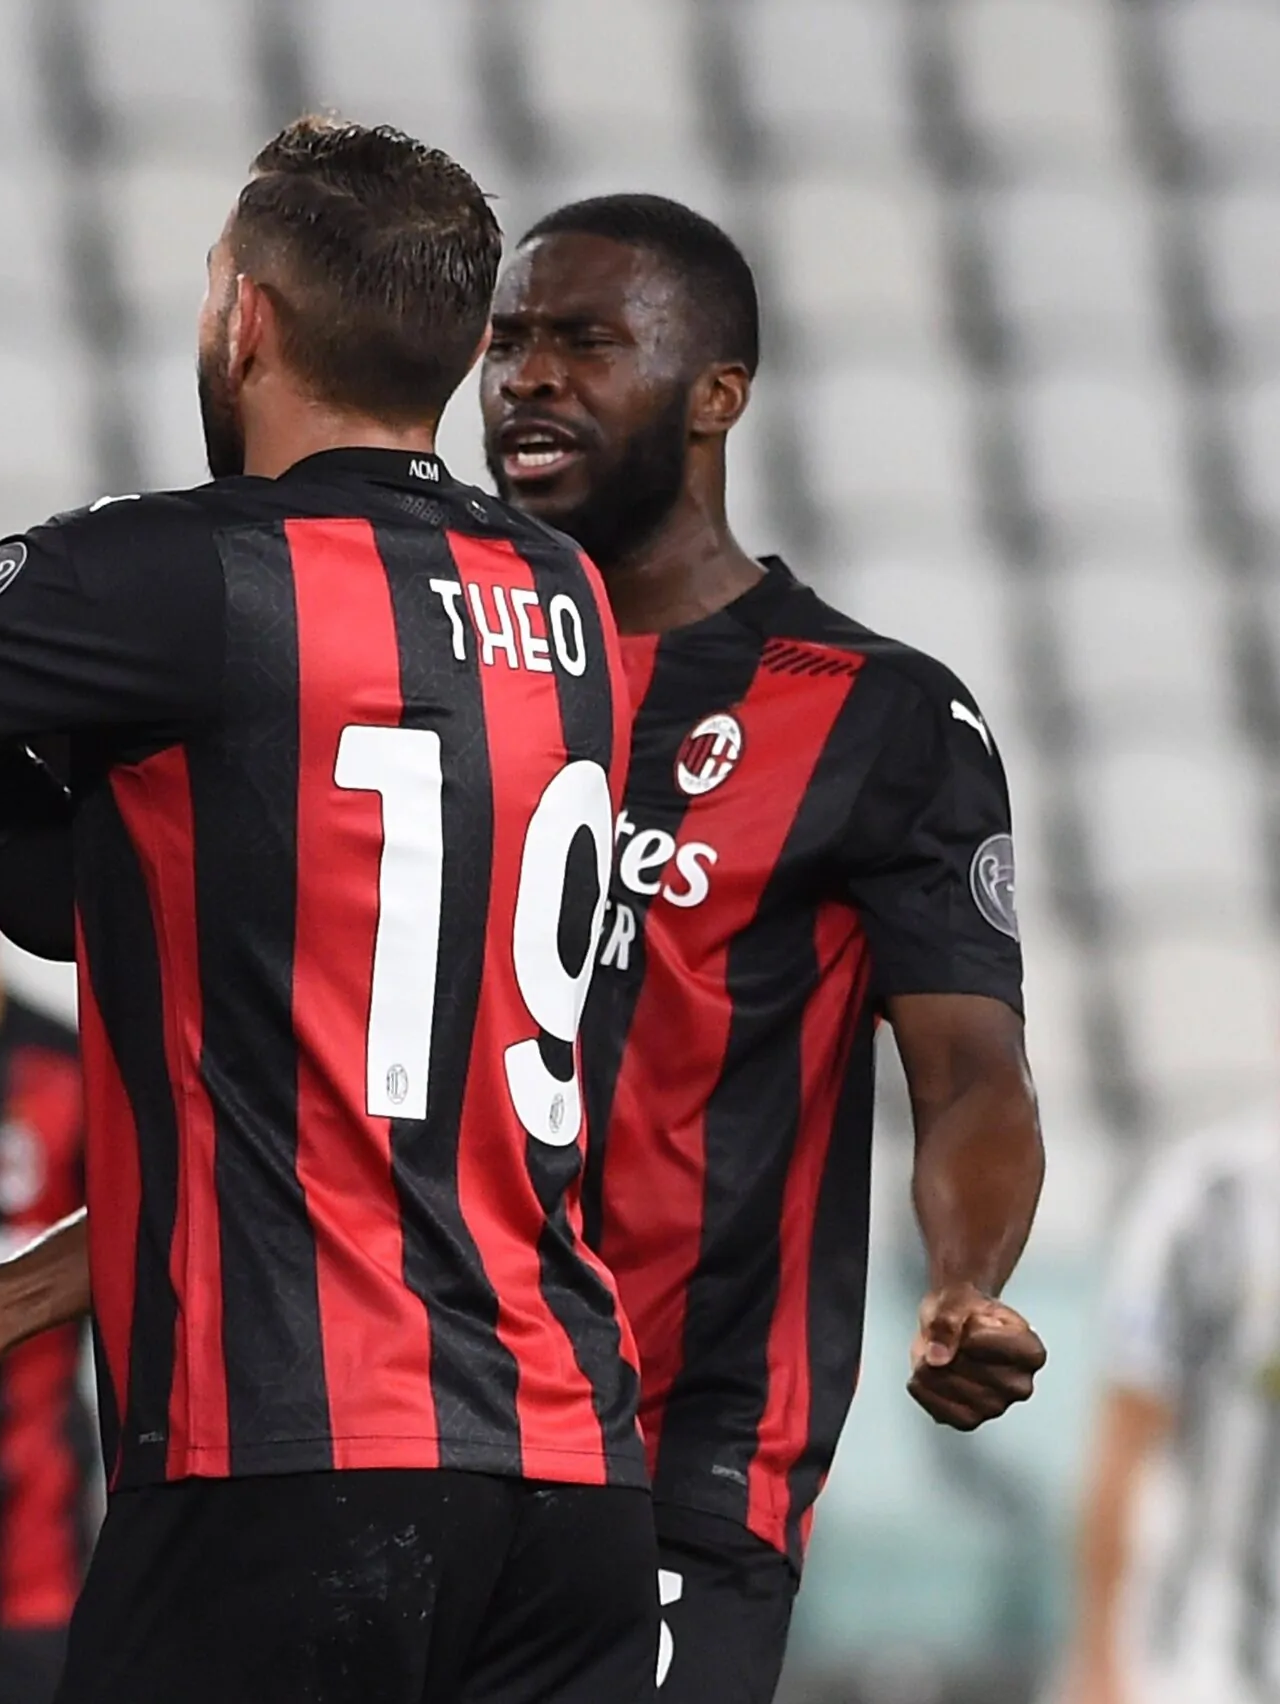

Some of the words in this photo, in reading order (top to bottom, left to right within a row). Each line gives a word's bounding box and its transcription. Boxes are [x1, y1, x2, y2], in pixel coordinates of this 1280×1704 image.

[408, 458, 440, 482] ACM
[428, 577, 588, 678] THEO
[334, 725, 613, 1147] 19
